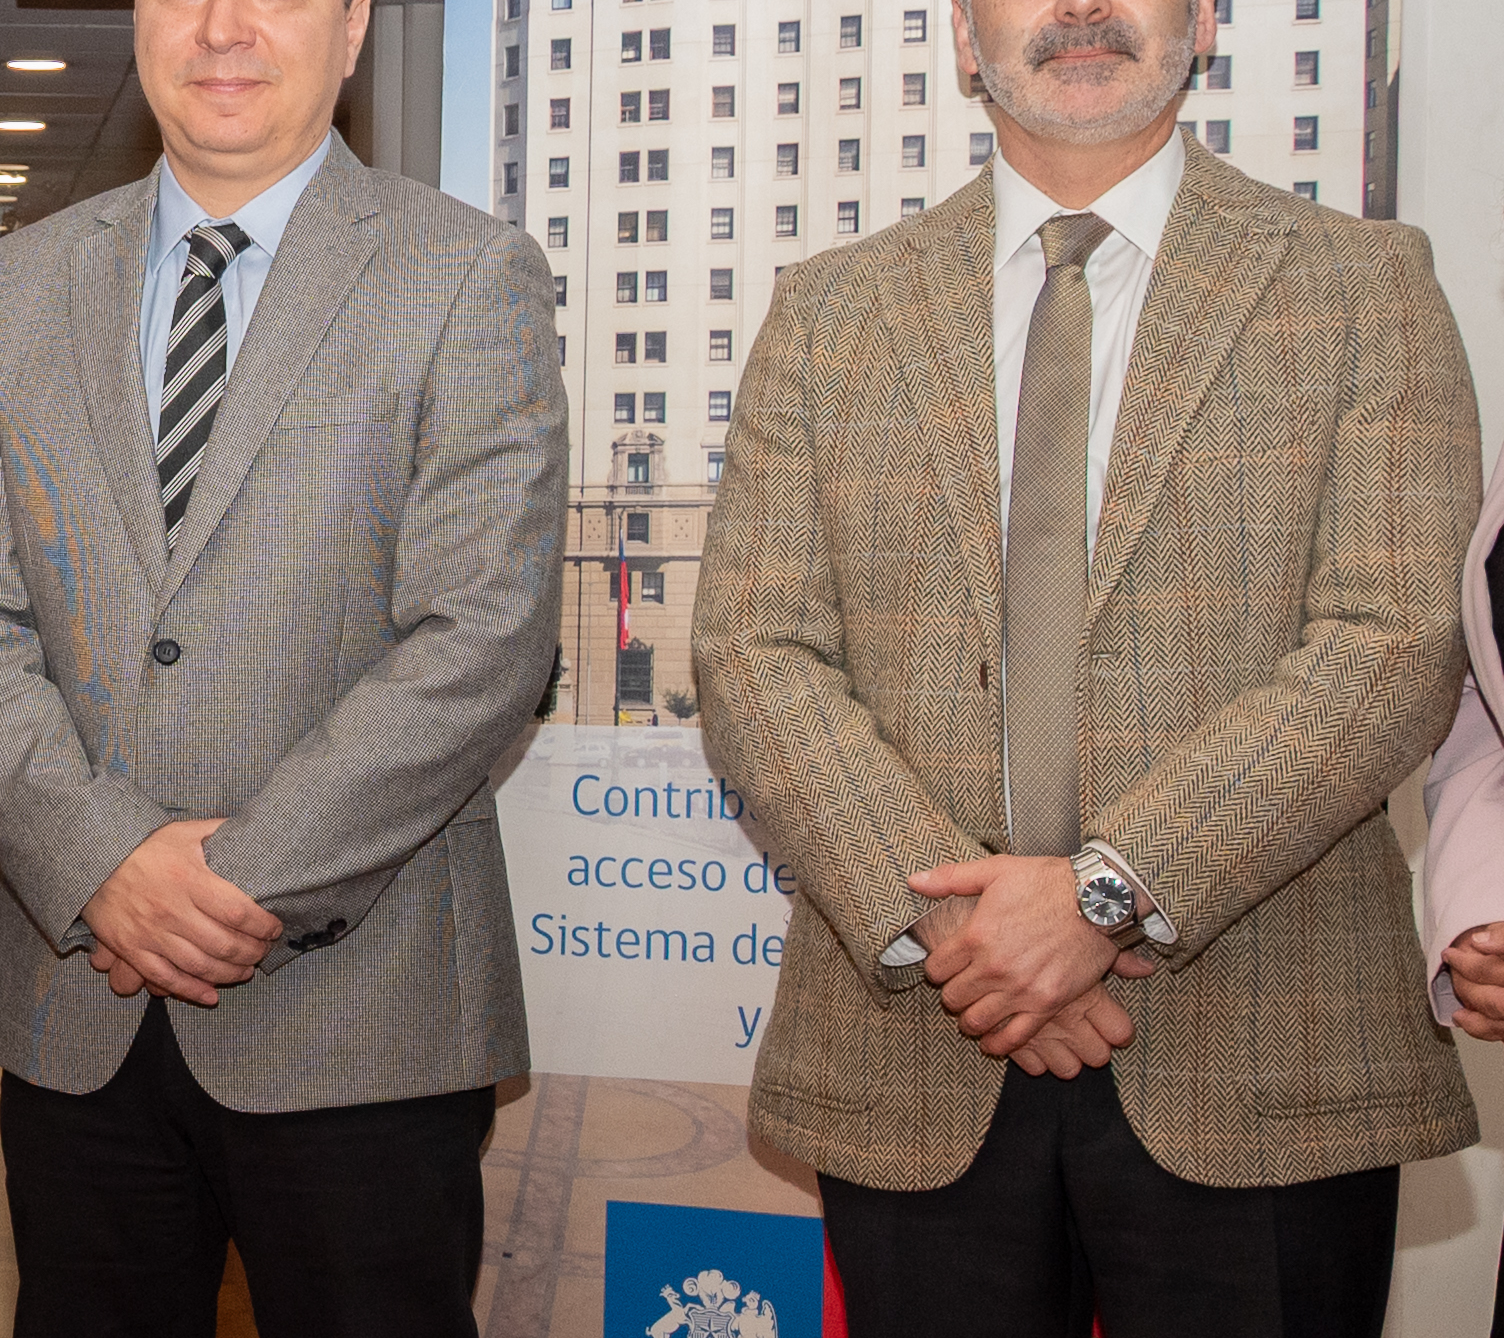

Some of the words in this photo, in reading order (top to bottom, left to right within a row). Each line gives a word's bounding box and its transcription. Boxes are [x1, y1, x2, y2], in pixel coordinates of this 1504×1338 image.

[572, 775, 757, 821] Contrib
[567, 855, 727, 893] acceso
[530, 913, 715, 963] Sistema
